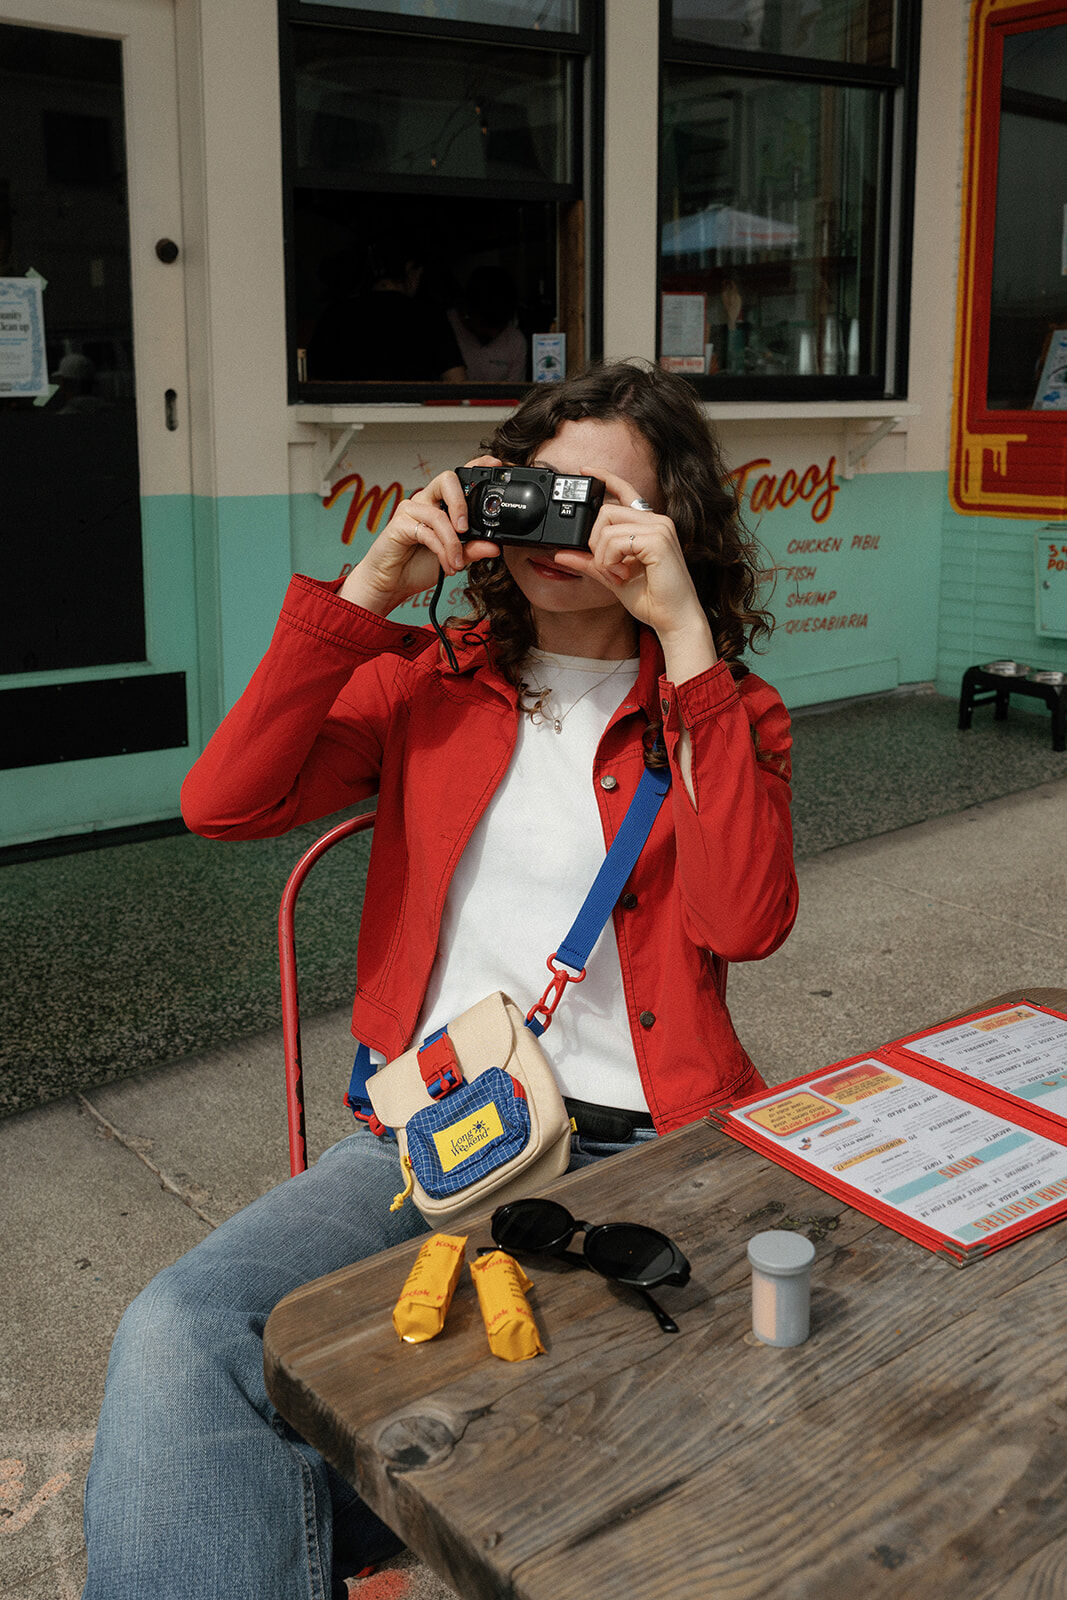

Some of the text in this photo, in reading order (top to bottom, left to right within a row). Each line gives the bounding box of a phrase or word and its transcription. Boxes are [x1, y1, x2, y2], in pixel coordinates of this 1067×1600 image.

[721, 456, 840, 524] Tacos
[501, 502, 527, 510] OLYMPUS
[787, 534, 881, 554] CHICKEN PIBIL
[785, 566, 817, 581] FISH
[785, 590, 837, 608] SHRIMP
[785, 613, 869, 635] QUESABIRRIA
[450, 1128, 476, 1149] Long
[451, 1126, 489, 1157] Weekend
[937, 1155, 985, 1179] MAINS
[971, 1198, 1041, 1233] PLATTERS
